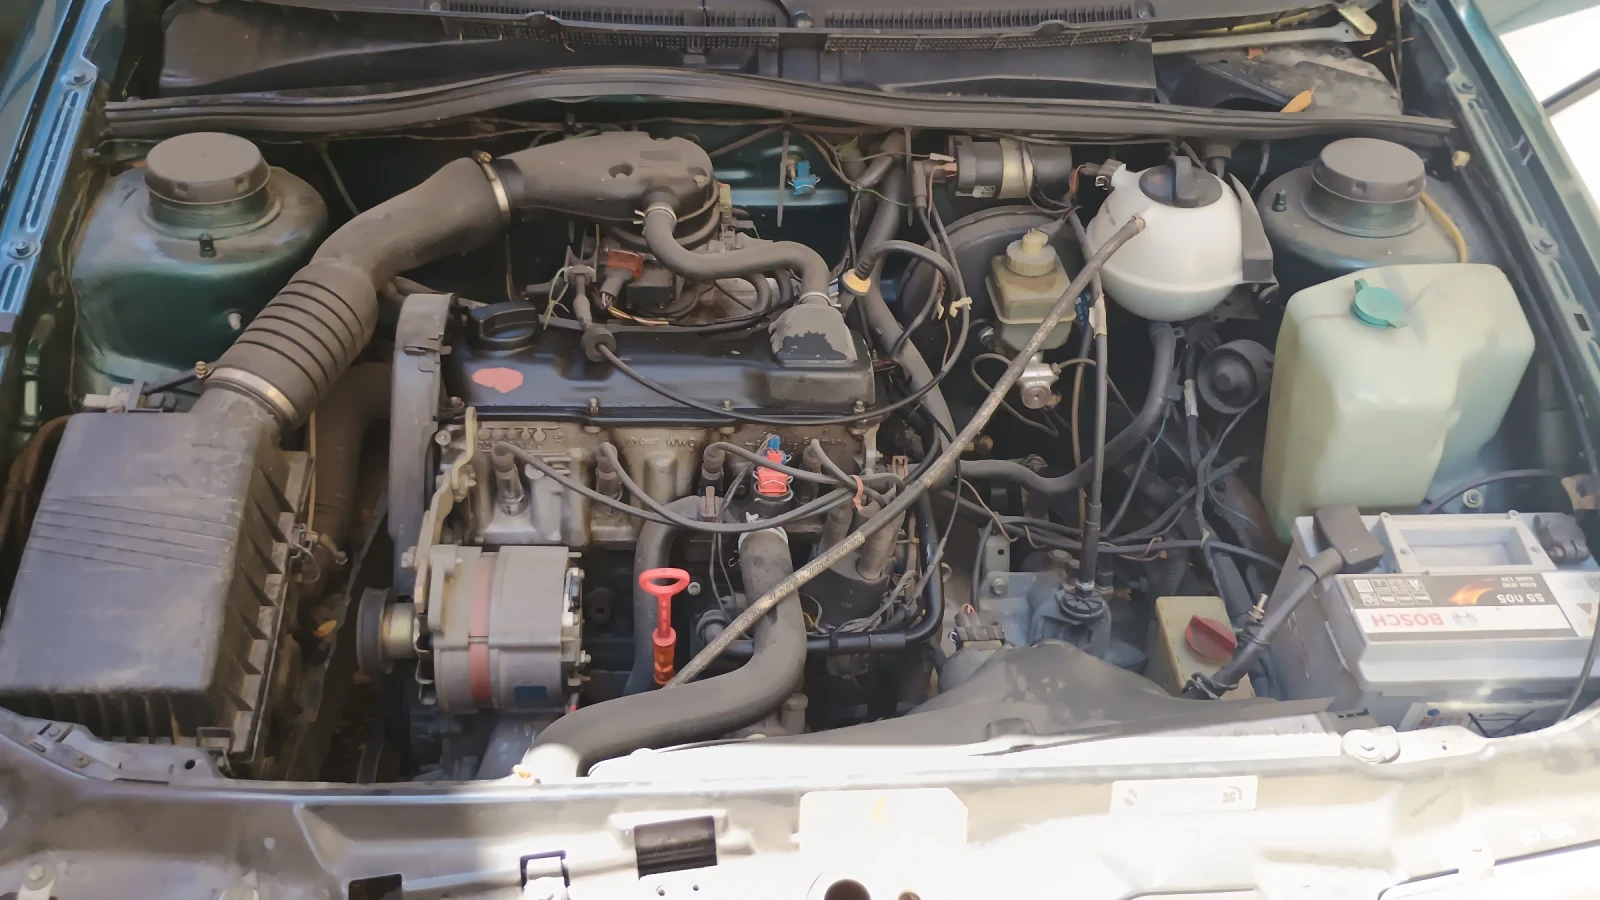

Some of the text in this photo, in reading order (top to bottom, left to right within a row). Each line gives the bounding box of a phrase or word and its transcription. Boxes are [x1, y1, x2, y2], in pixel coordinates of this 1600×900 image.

[803, 436, 847, 448] Gmany
[1526, 593, 1545, 603] S5
[1371, 613, 1444, 627] BOSCH
